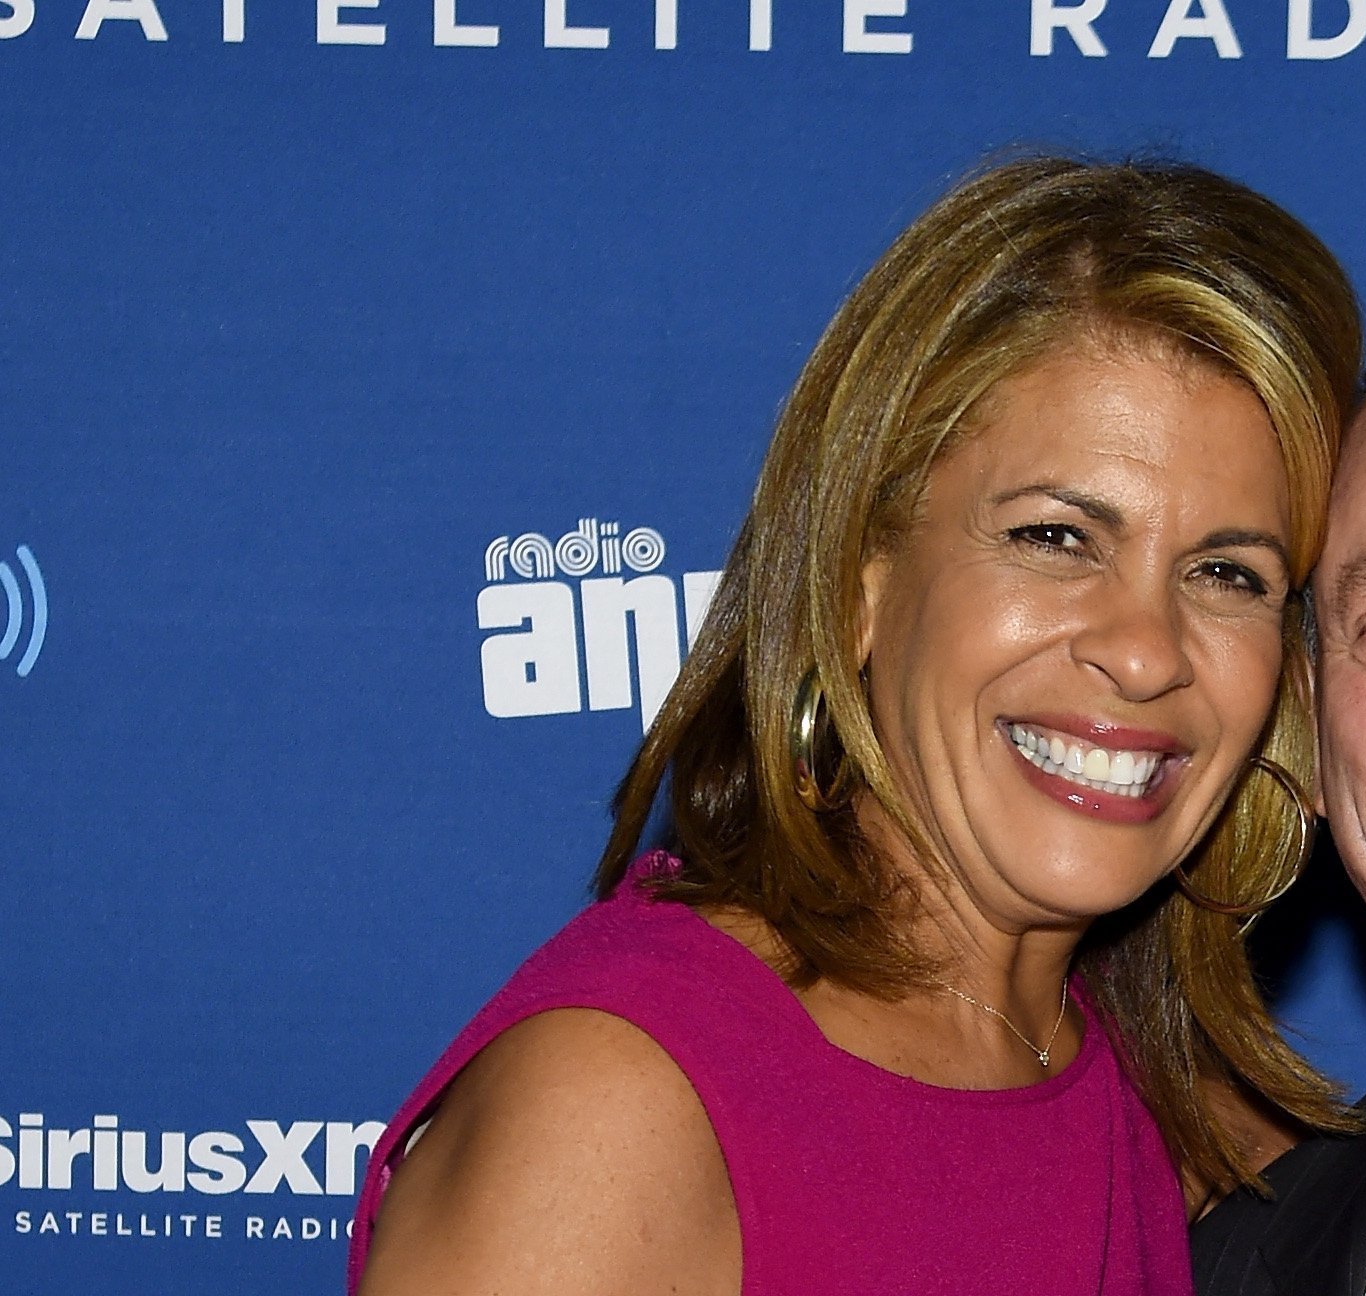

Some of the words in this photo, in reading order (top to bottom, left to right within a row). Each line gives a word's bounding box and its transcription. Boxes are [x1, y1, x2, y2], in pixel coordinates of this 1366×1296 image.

[0, 0, 914, 54] ATELLITE
[484, 517, 666, 581] radio
[15, 1211, 223, 1238] SATELLITE
